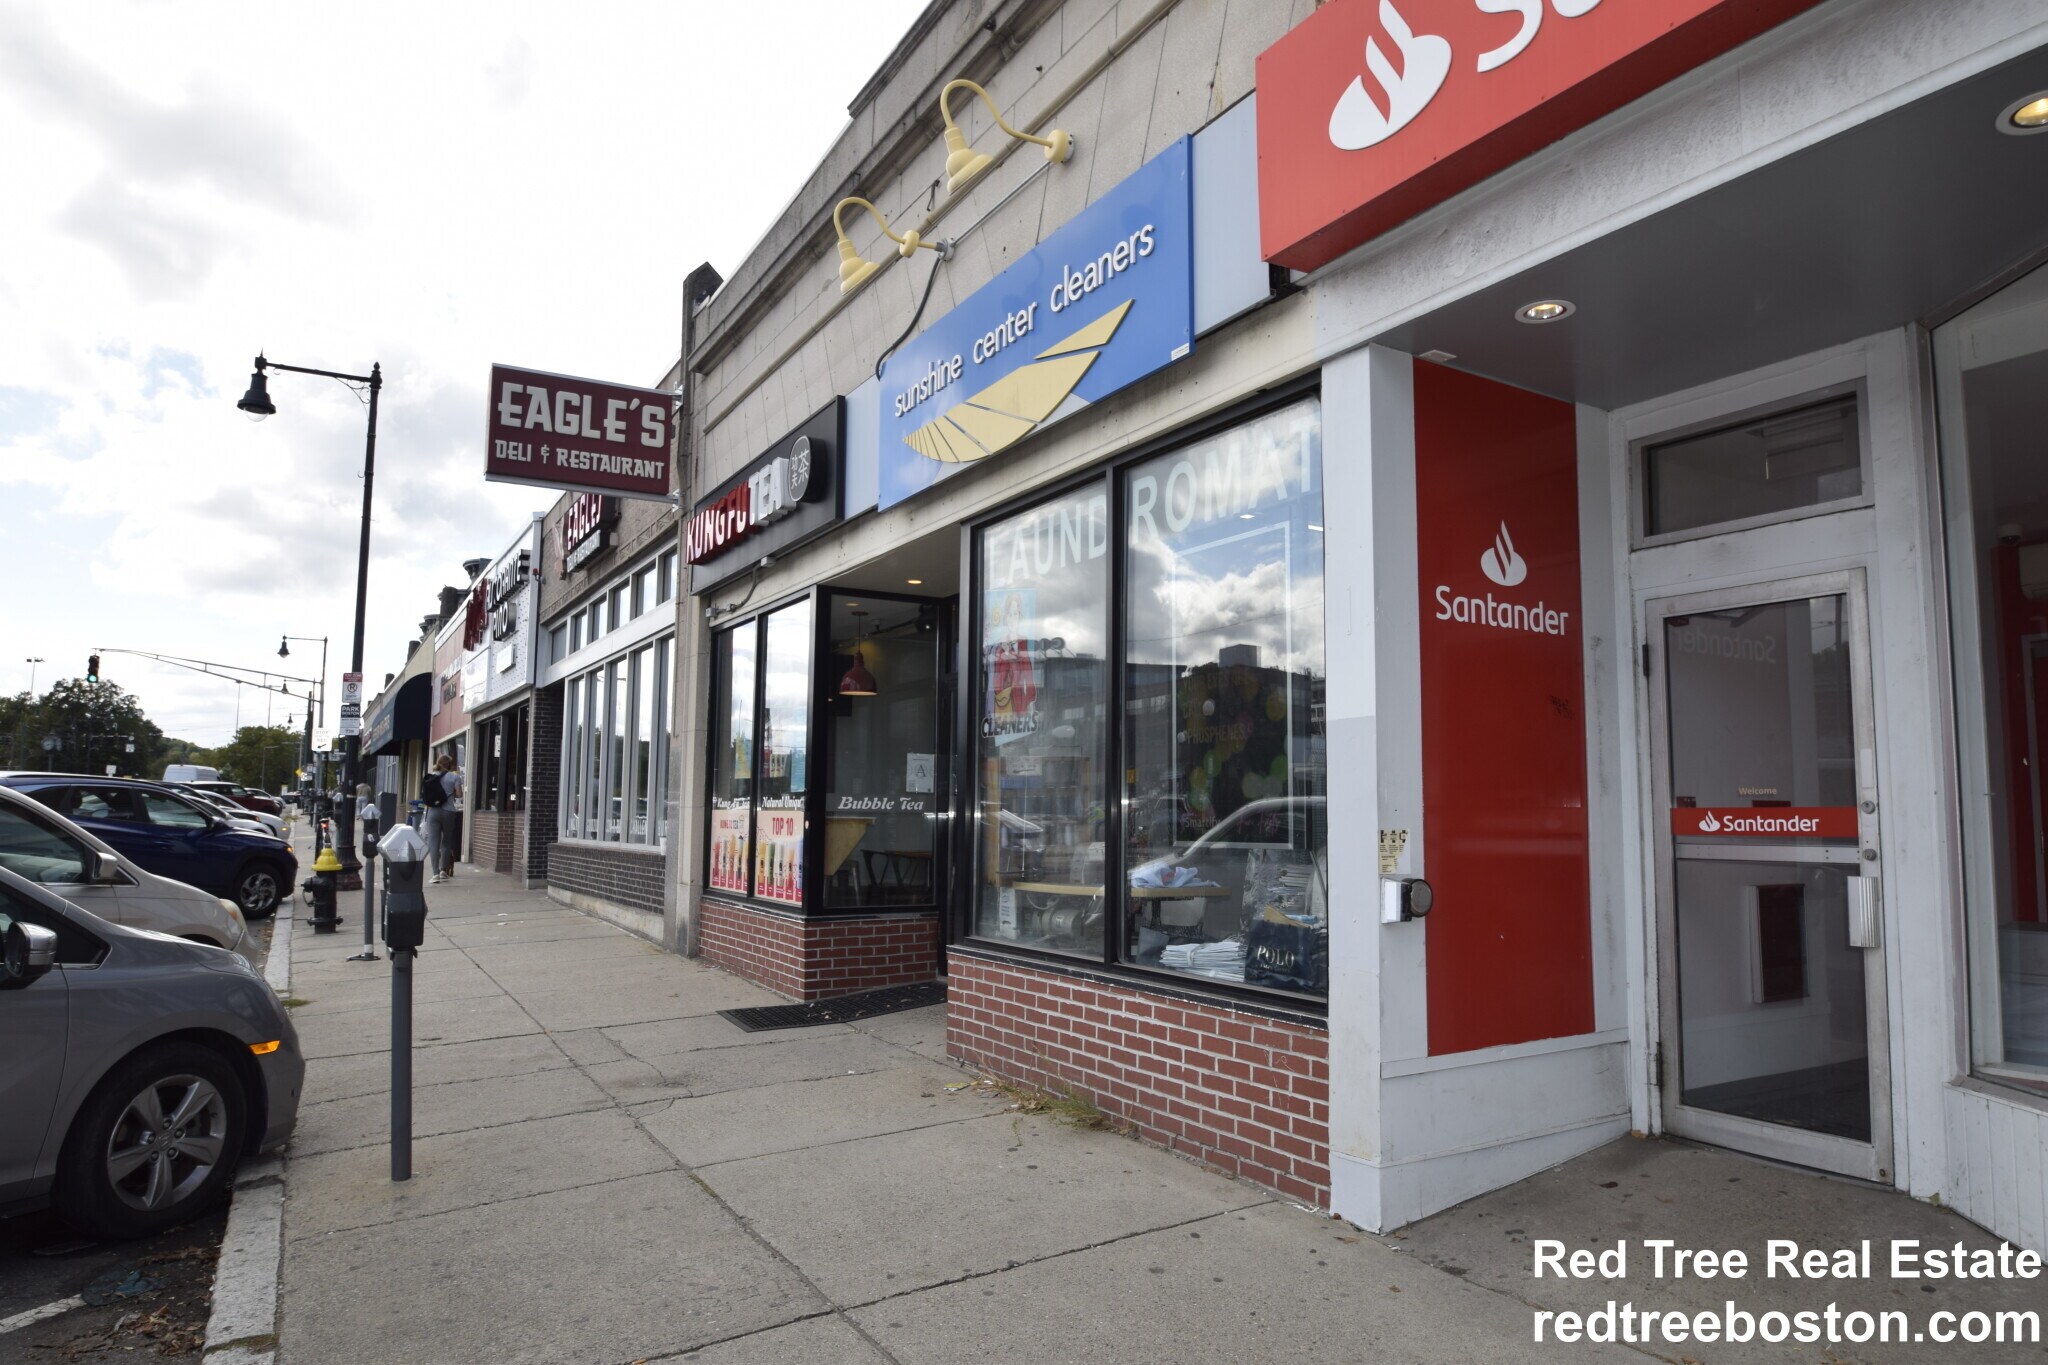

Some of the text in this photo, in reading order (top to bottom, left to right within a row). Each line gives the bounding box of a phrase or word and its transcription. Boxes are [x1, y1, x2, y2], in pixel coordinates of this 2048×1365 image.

[894, 224, 1155, 417] sunshine center cleaners
[497, 381, 666, 448] EAGLE'S
[495, 439, 665, 480] DELI & RESTAURANT
[1435, 585, 1569, 636] Santander
[981, 711, 1039, 738] CLEANERS
[838, 796, 924, 811] Bubble Tea
[1738, 787, 1777, 795] Welcome
[772, 817, 794, 837] TOP 10
[1723, 815, 1820, 832] Santander
[1257, 945, 1295, 969] POLO
